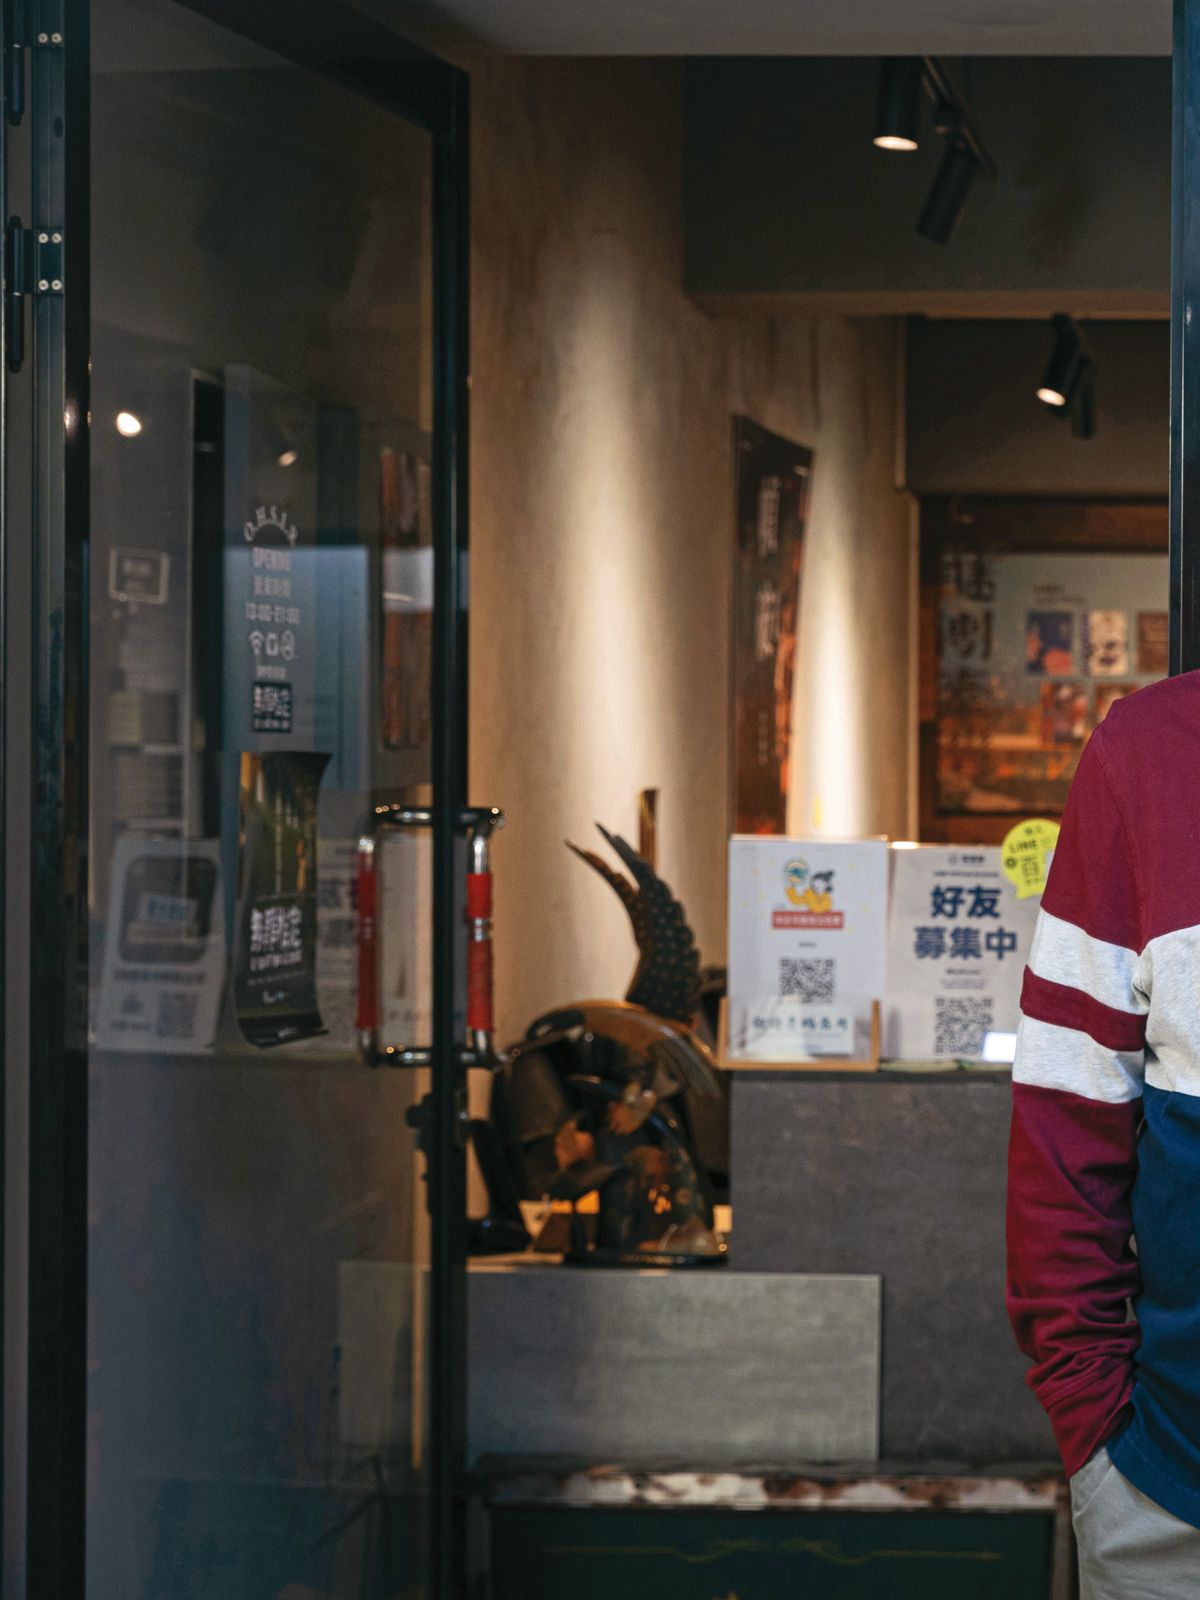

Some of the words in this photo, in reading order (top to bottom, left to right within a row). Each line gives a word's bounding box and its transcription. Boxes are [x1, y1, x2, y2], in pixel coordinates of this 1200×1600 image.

[930, 885, 1002, 919] 好友
[913, 926, 1018, 960] 募集中
